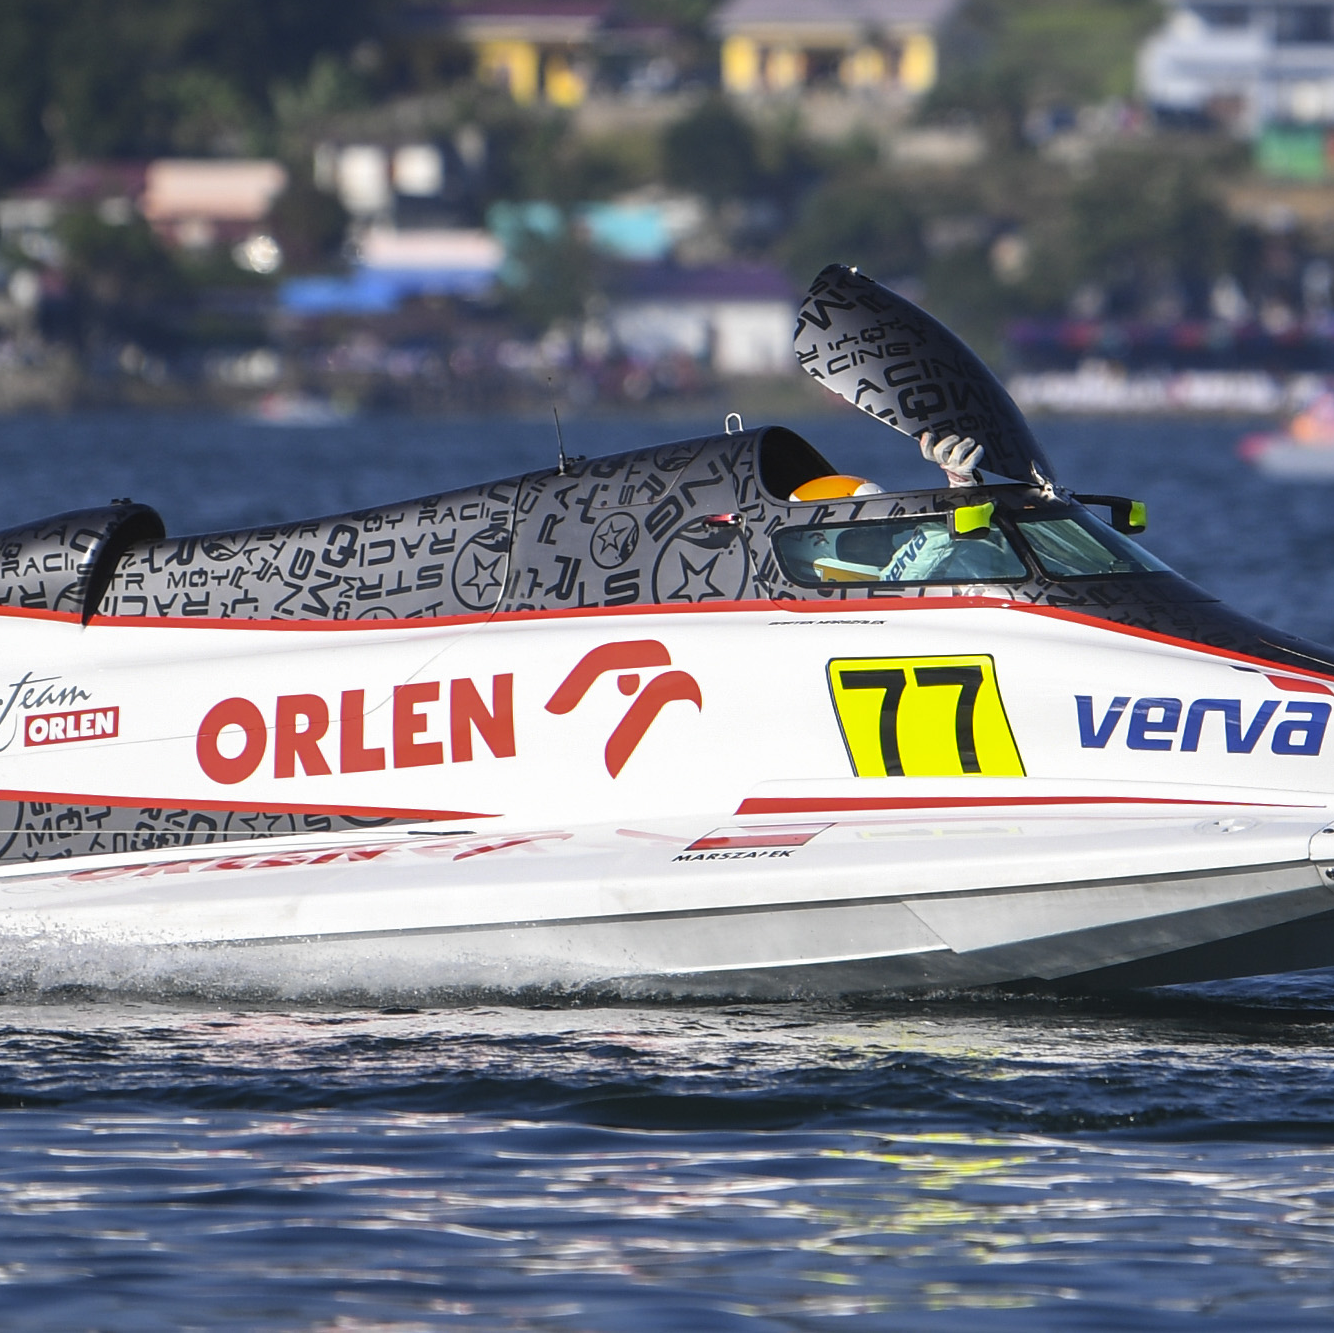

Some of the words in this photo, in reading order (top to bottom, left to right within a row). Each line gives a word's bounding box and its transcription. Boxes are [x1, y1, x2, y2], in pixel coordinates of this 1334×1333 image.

[28, 711, 114, 743] ORLEN
[196, 673, 516, 785] ORLEN
[839, 665, 984, 777] 77
[1074, 695, 1332, 756] verva
